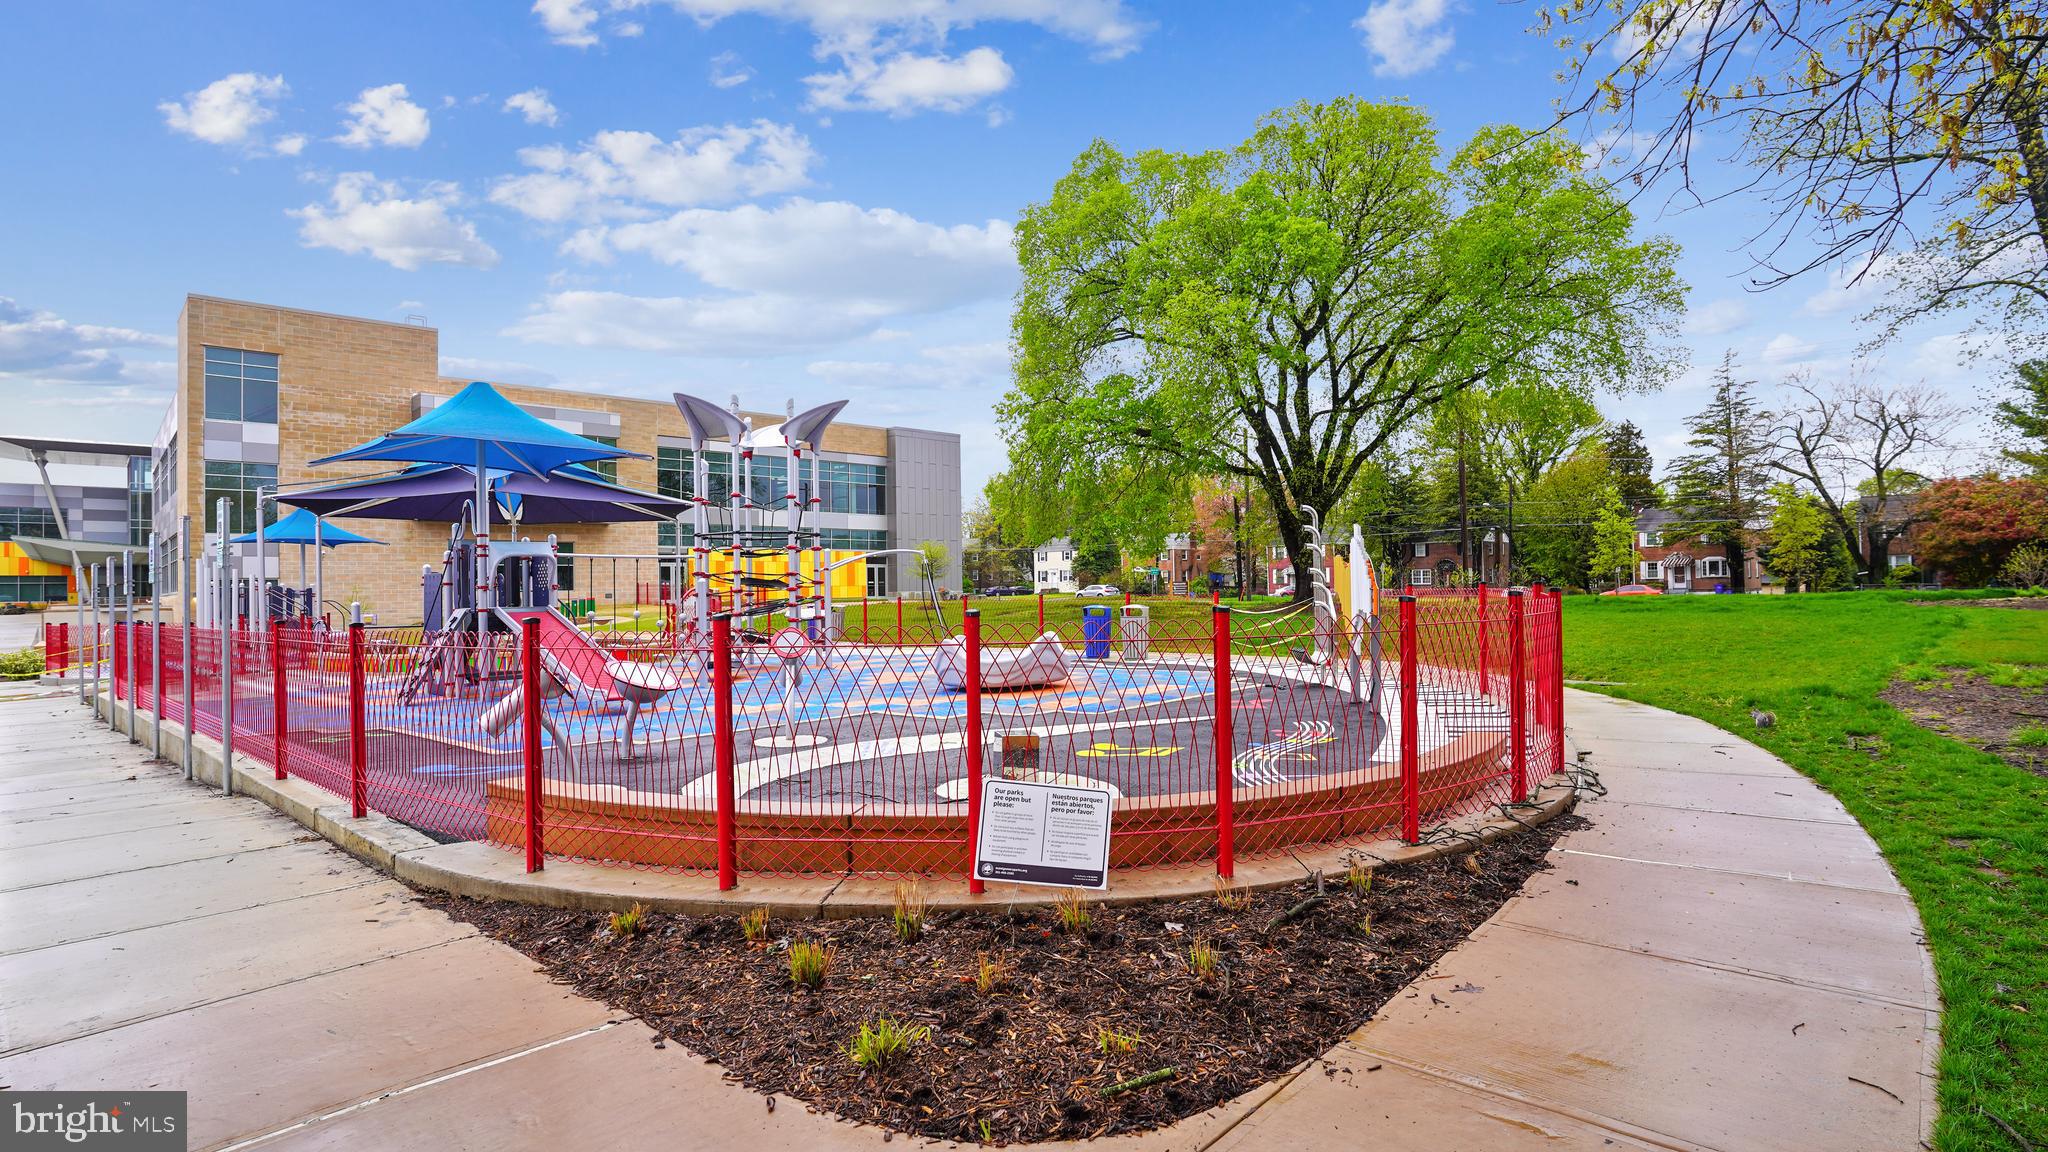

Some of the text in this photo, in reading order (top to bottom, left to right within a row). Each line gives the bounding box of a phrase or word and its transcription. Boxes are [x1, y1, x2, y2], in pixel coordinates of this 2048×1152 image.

[1052, 793, 1103, 804] Nuestros parques
[1069, 801, 1096, 810] abiertos,
[1077, 808, 1095, 816] favor:
